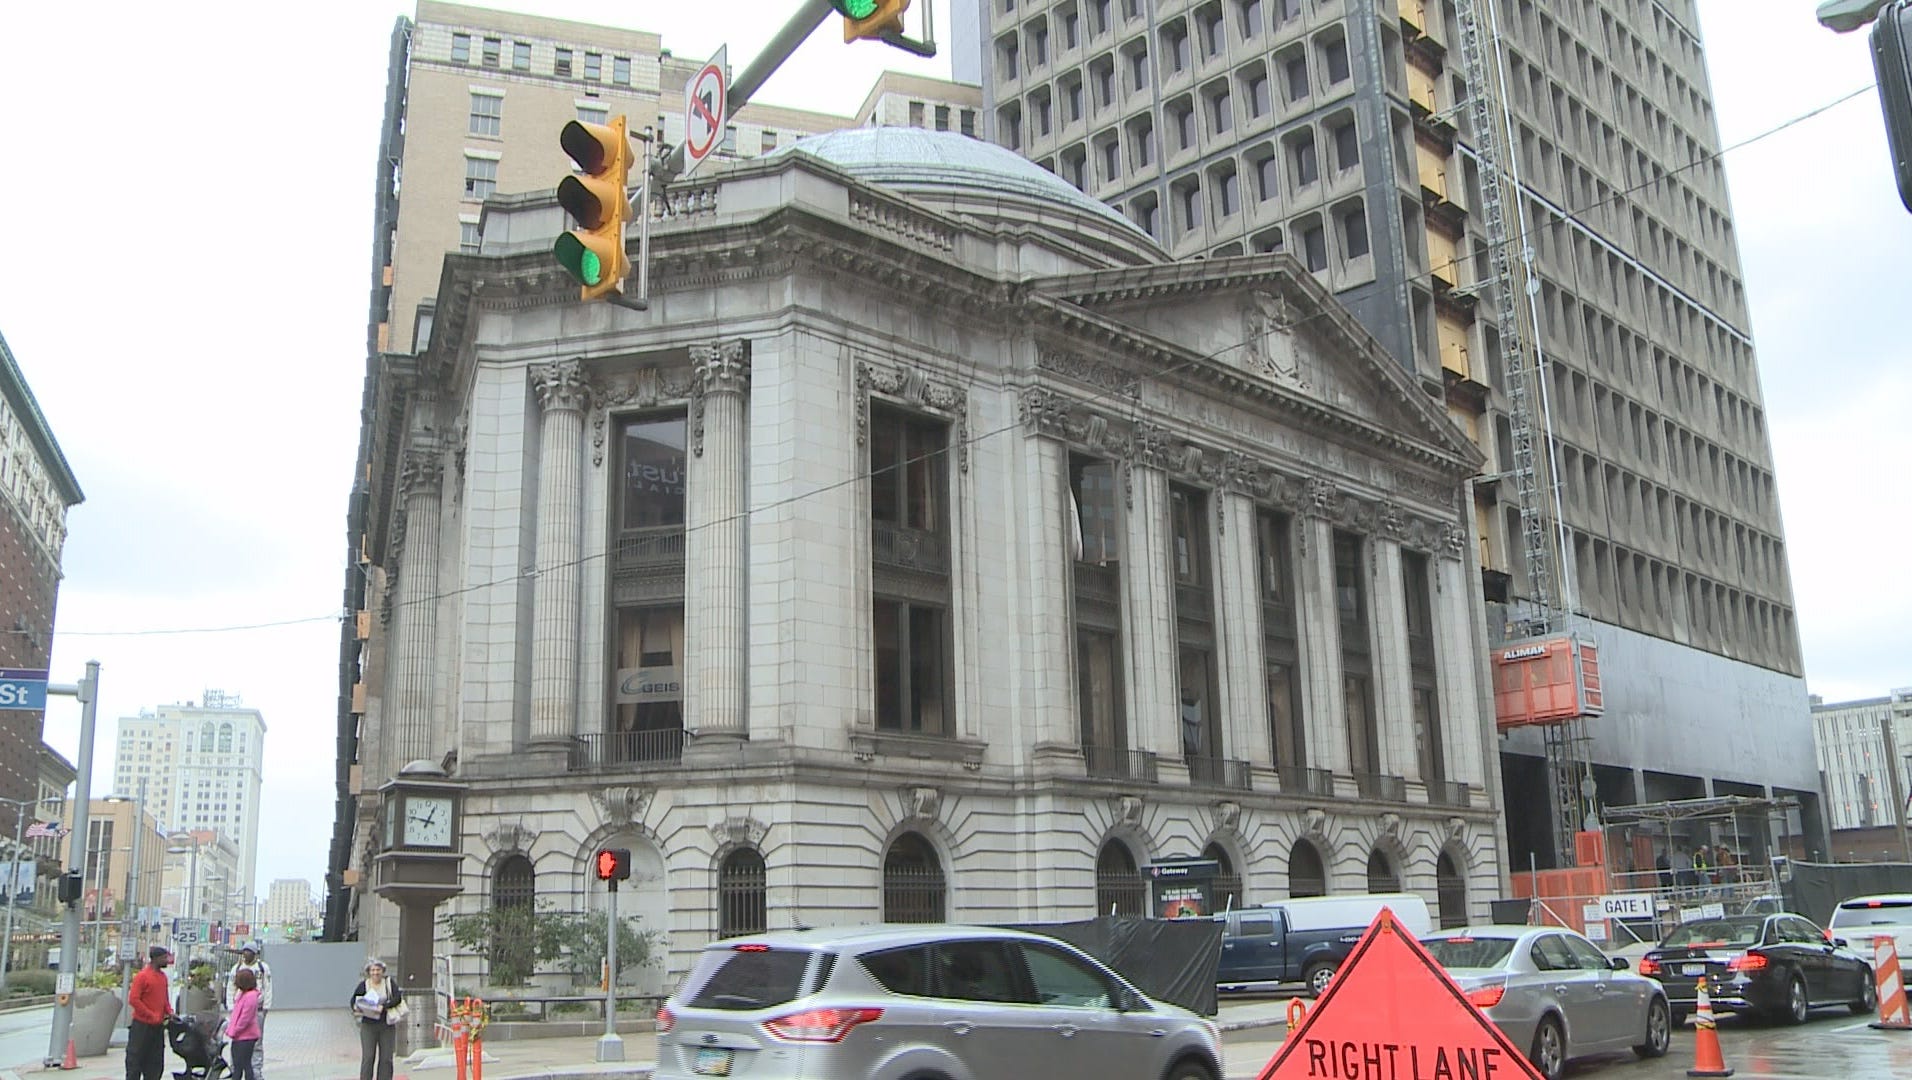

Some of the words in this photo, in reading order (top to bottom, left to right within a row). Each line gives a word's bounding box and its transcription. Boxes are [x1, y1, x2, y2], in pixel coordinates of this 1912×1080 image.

[1504, 645, 1546, 659] ALIMAK
[0, 683, 28, 705] St
[642, 682, 680, 693] GEIS
[1161, 867, 1188, 876] Gateway
[1605, 899, 1640, 914] GATE
[1641, 900, 1648, 913] 1
[179, 932, 197, 942] 25
[1305, 1038, 1398, 1080] RIGHT
[1411, 1045, 1501, 1080] LANE
